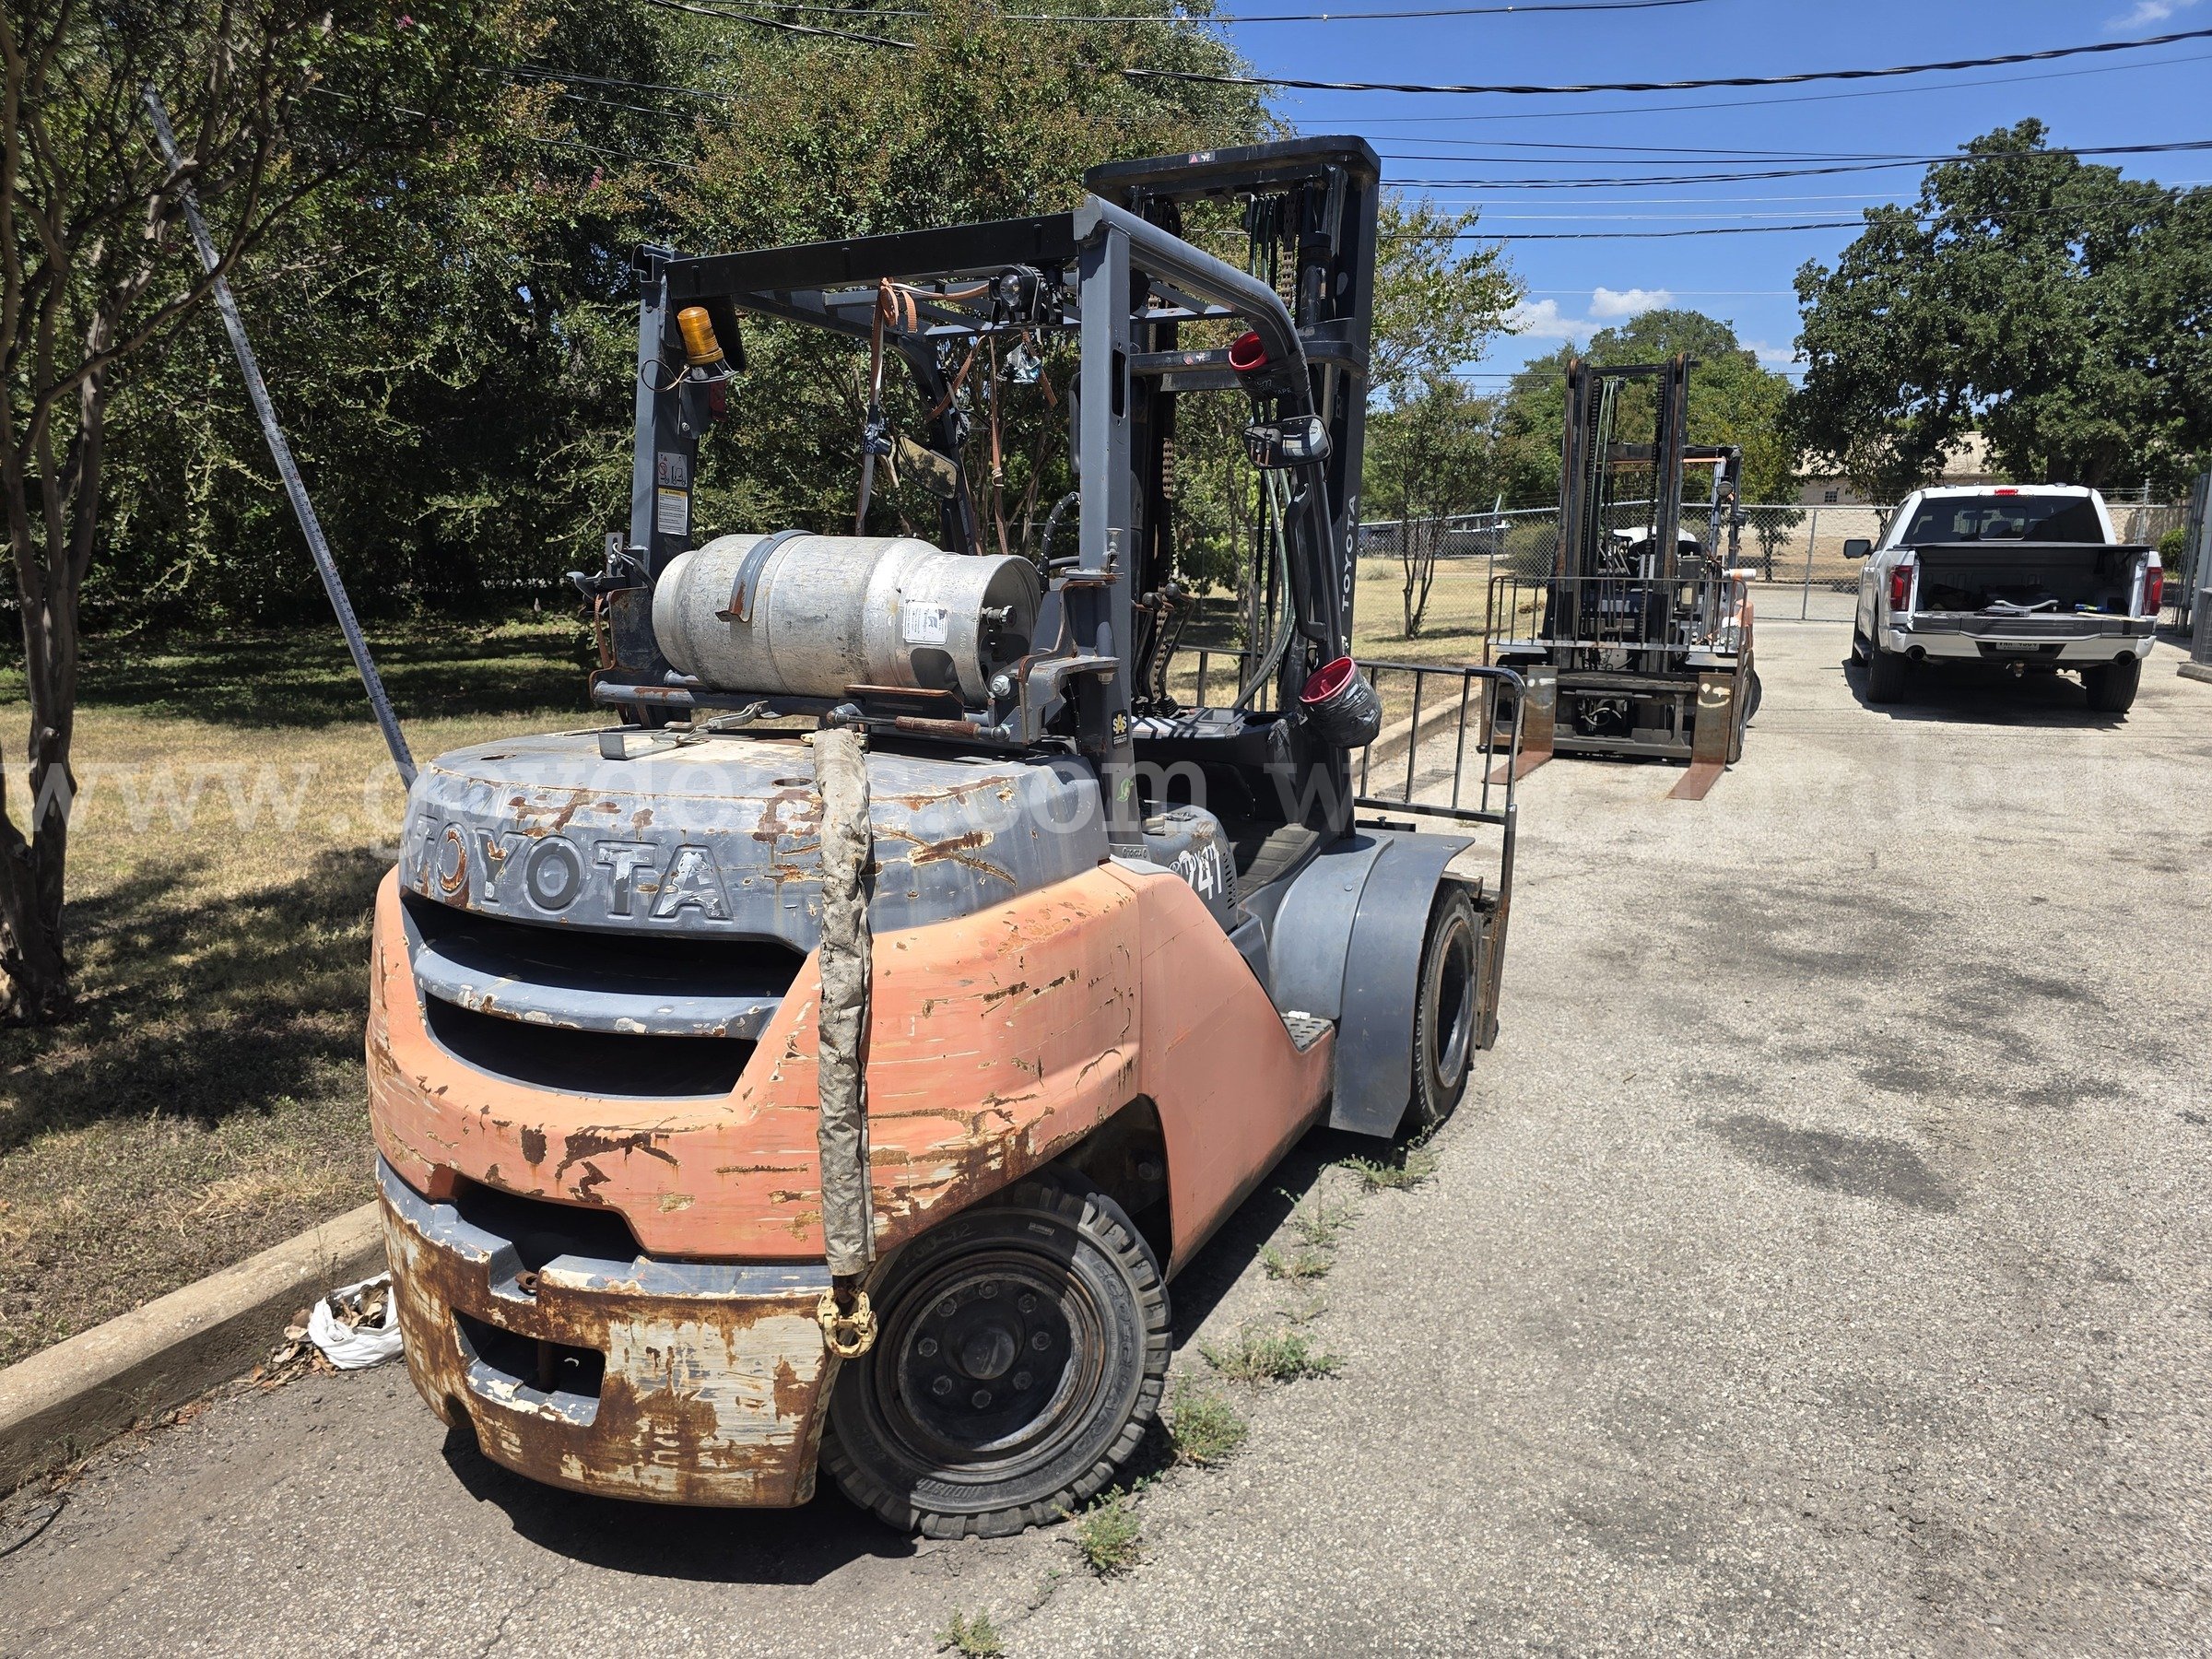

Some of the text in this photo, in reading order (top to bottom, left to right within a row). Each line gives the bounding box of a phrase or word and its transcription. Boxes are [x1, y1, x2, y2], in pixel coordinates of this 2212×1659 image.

[1341, 494, 1357, 612] TOYOTA
[1112, 713, 1127, 735] SAS
[414, 812, 735, 924] TOYOTA
